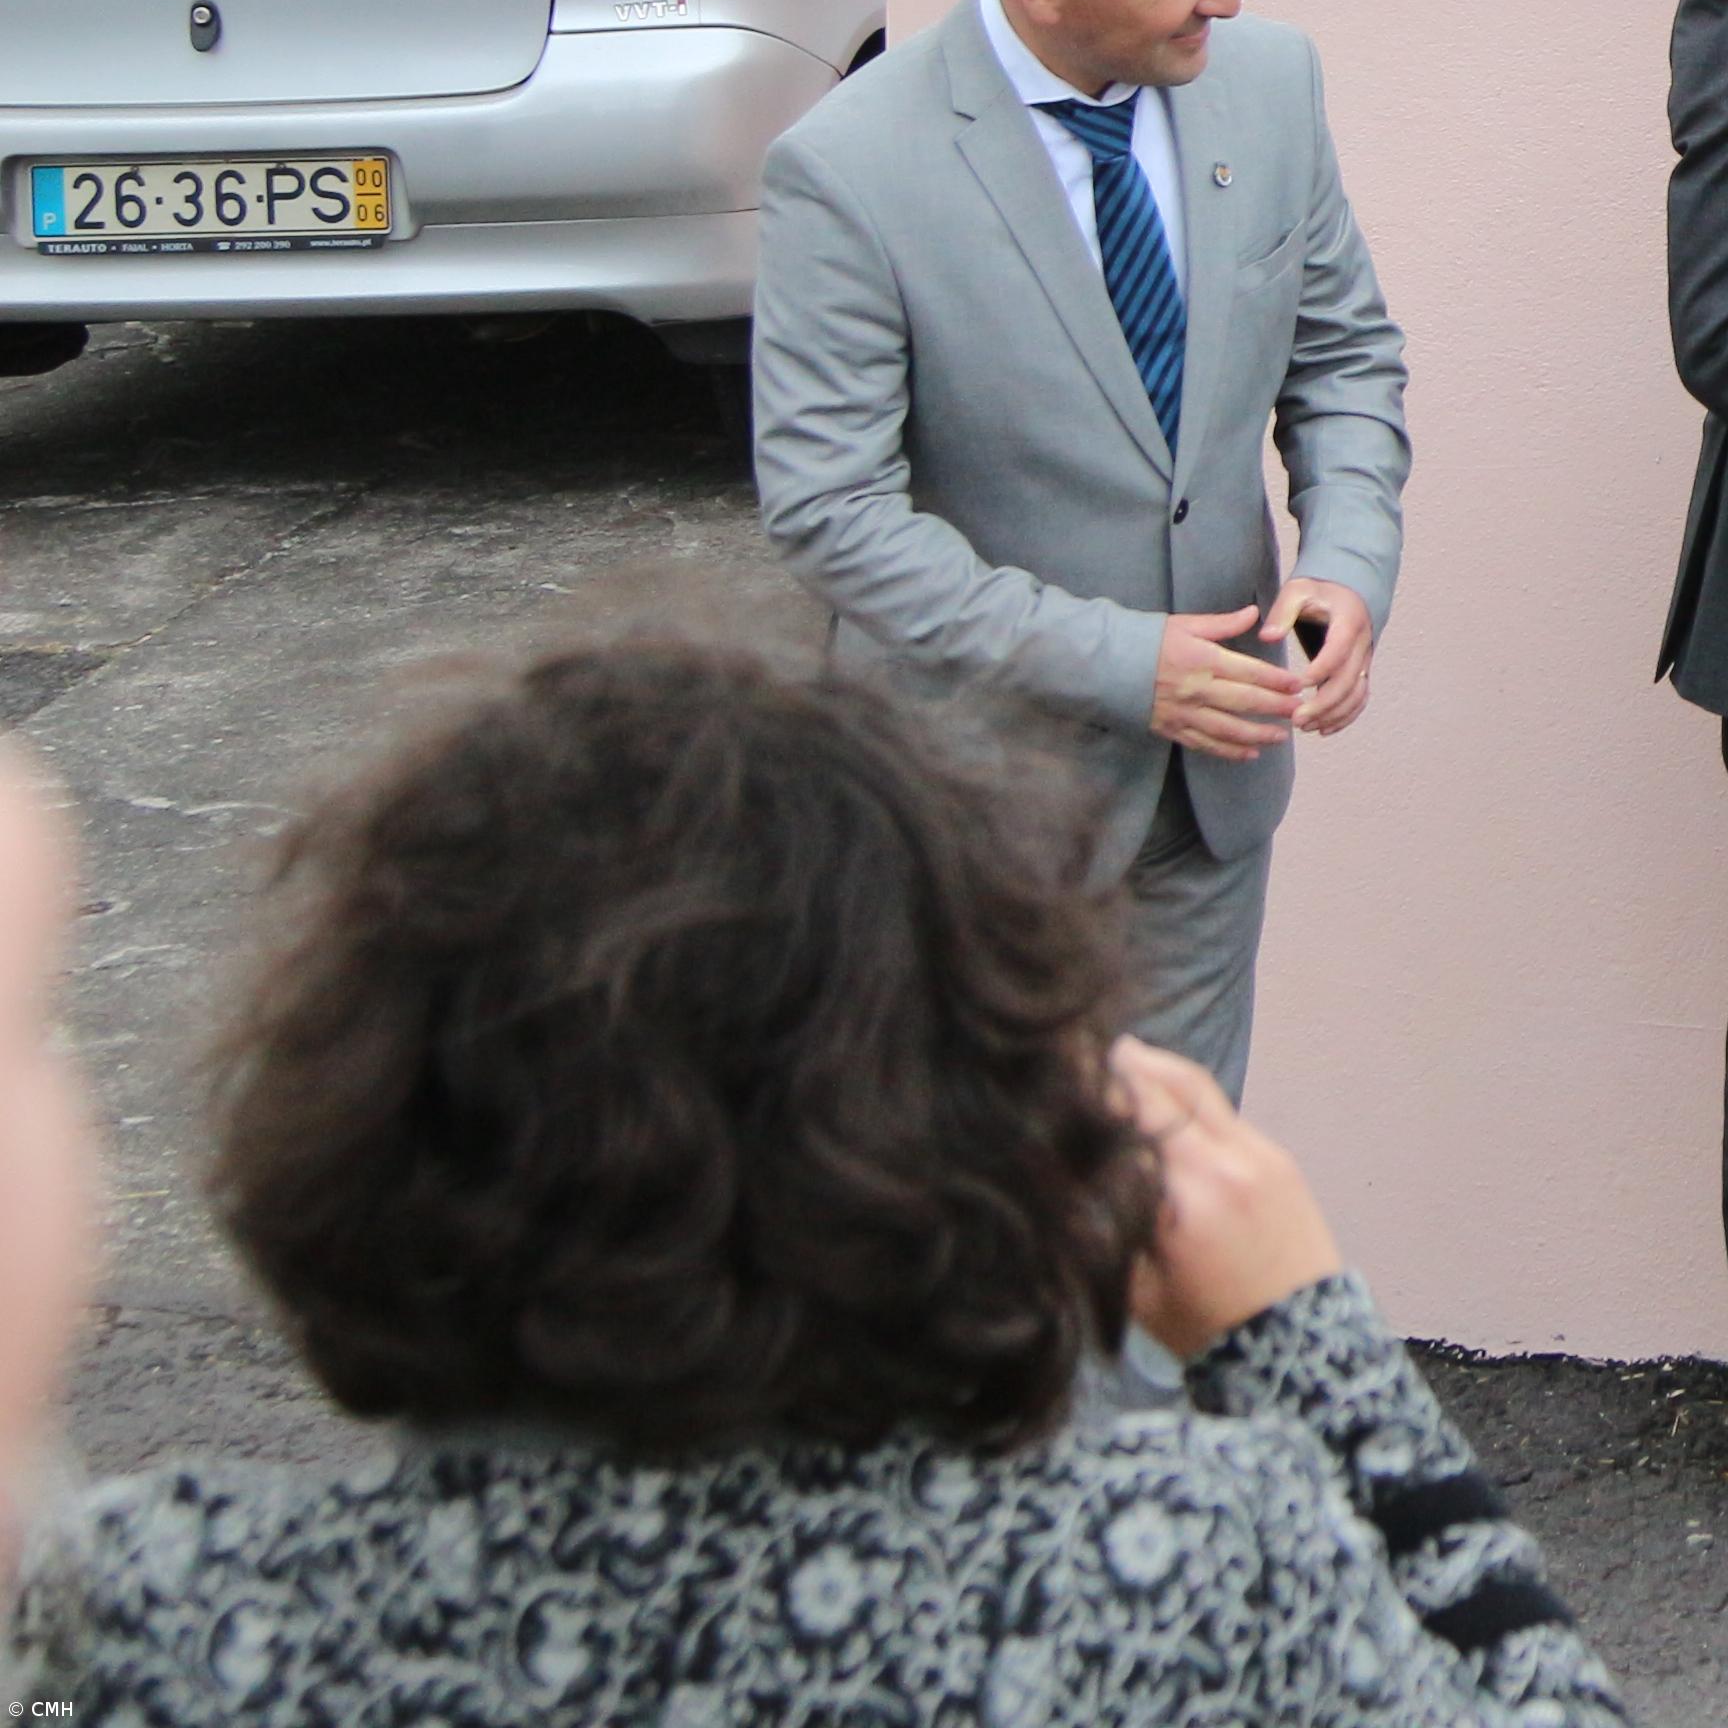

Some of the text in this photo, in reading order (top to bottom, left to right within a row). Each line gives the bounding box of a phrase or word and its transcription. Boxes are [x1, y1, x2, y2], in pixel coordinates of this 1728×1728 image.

[354, 168, 383, 188] 00
[43, 212, 57, 229] P
[356, 206, 386, 222] 06
[48, 243, 107, 254] TERAUTO
